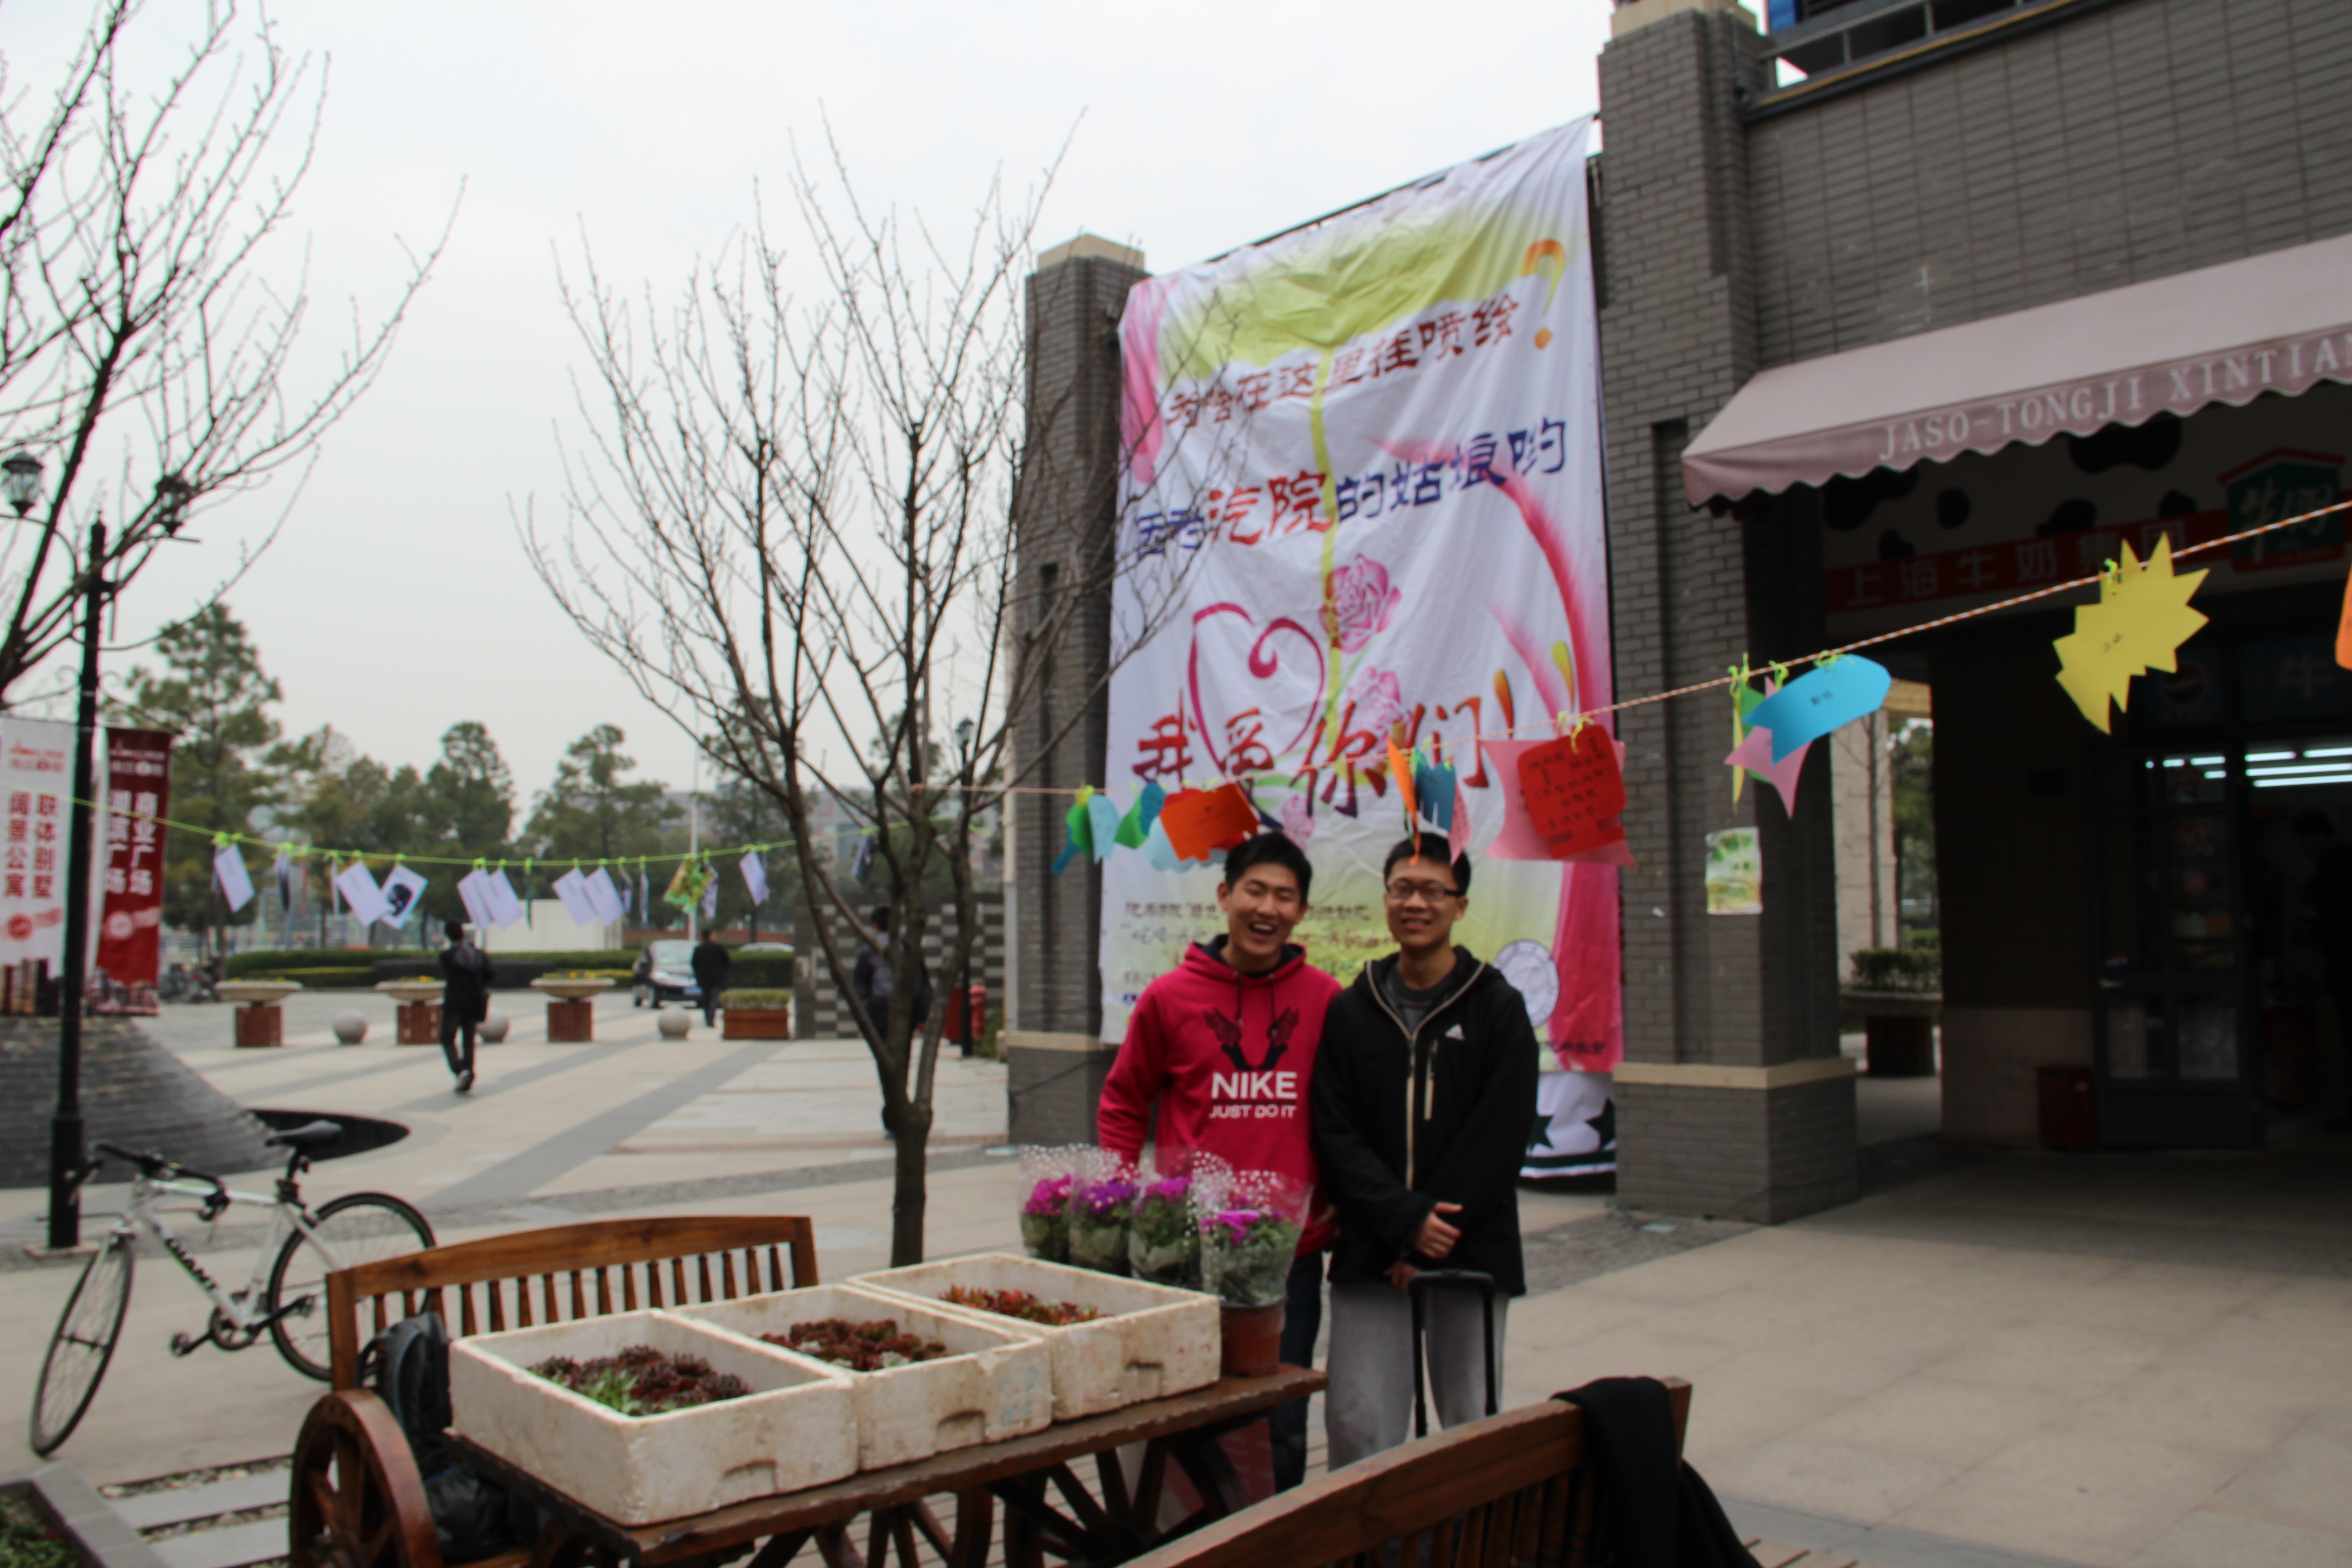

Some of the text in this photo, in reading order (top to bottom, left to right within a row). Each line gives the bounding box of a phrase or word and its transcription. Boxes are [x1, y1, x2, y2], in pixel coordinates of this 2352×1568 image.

[1878, 376, 2144, 461] JASO-TONGJI
[1211, 1071, 1298, 1099] NIKE
[1209, 1103, 1297, 1119] JUST DO IT
